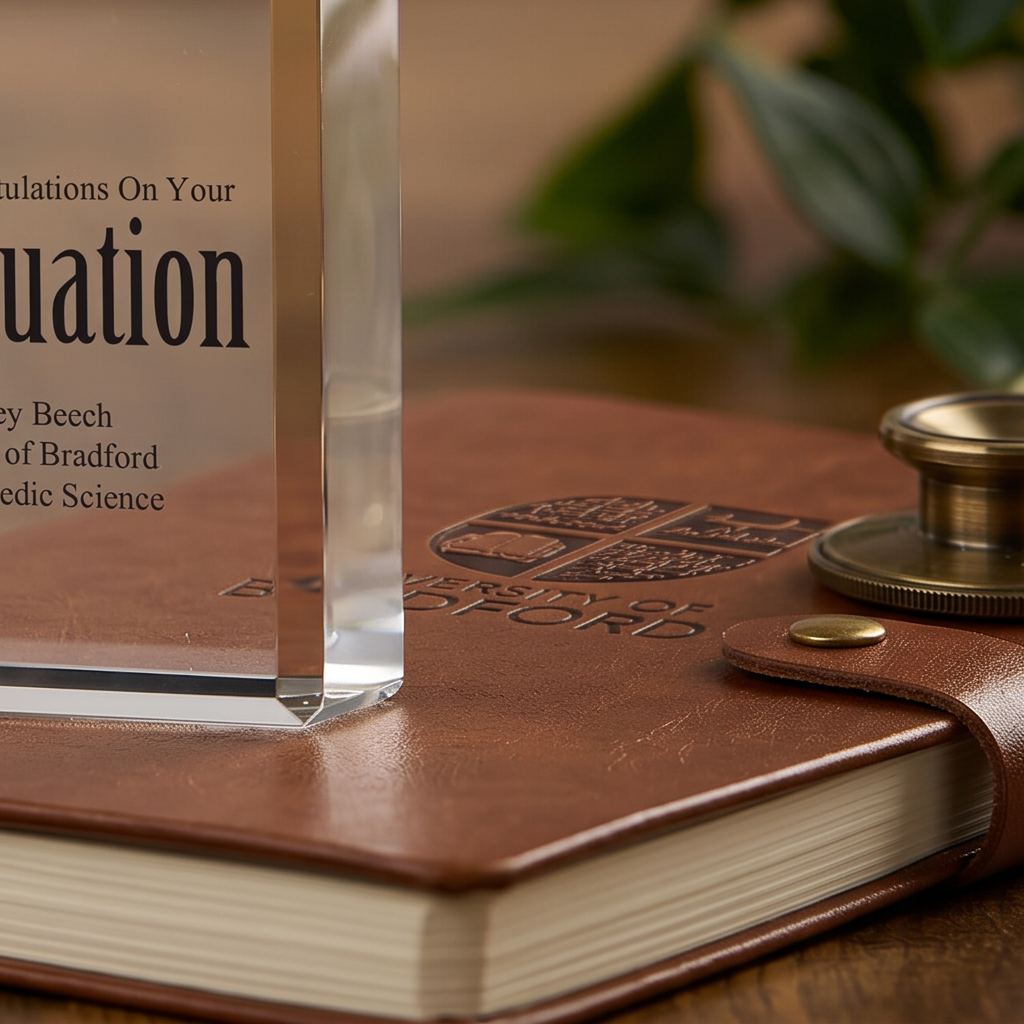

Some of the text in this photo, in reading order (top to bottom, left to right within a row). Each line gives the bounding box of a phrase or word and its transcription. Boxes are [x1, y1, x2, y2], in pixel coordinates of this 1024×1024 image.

[118, 176, 159, 202] On
[166, 176, 236, 203] Your
[32, 401, 113, 428] Beech
[4, 440, 35, 466] of
[39, 441, 159, 470] Bradford
[61, 482, 165, 512] Science
[404, 573, 714, 616] VERSITY OF
